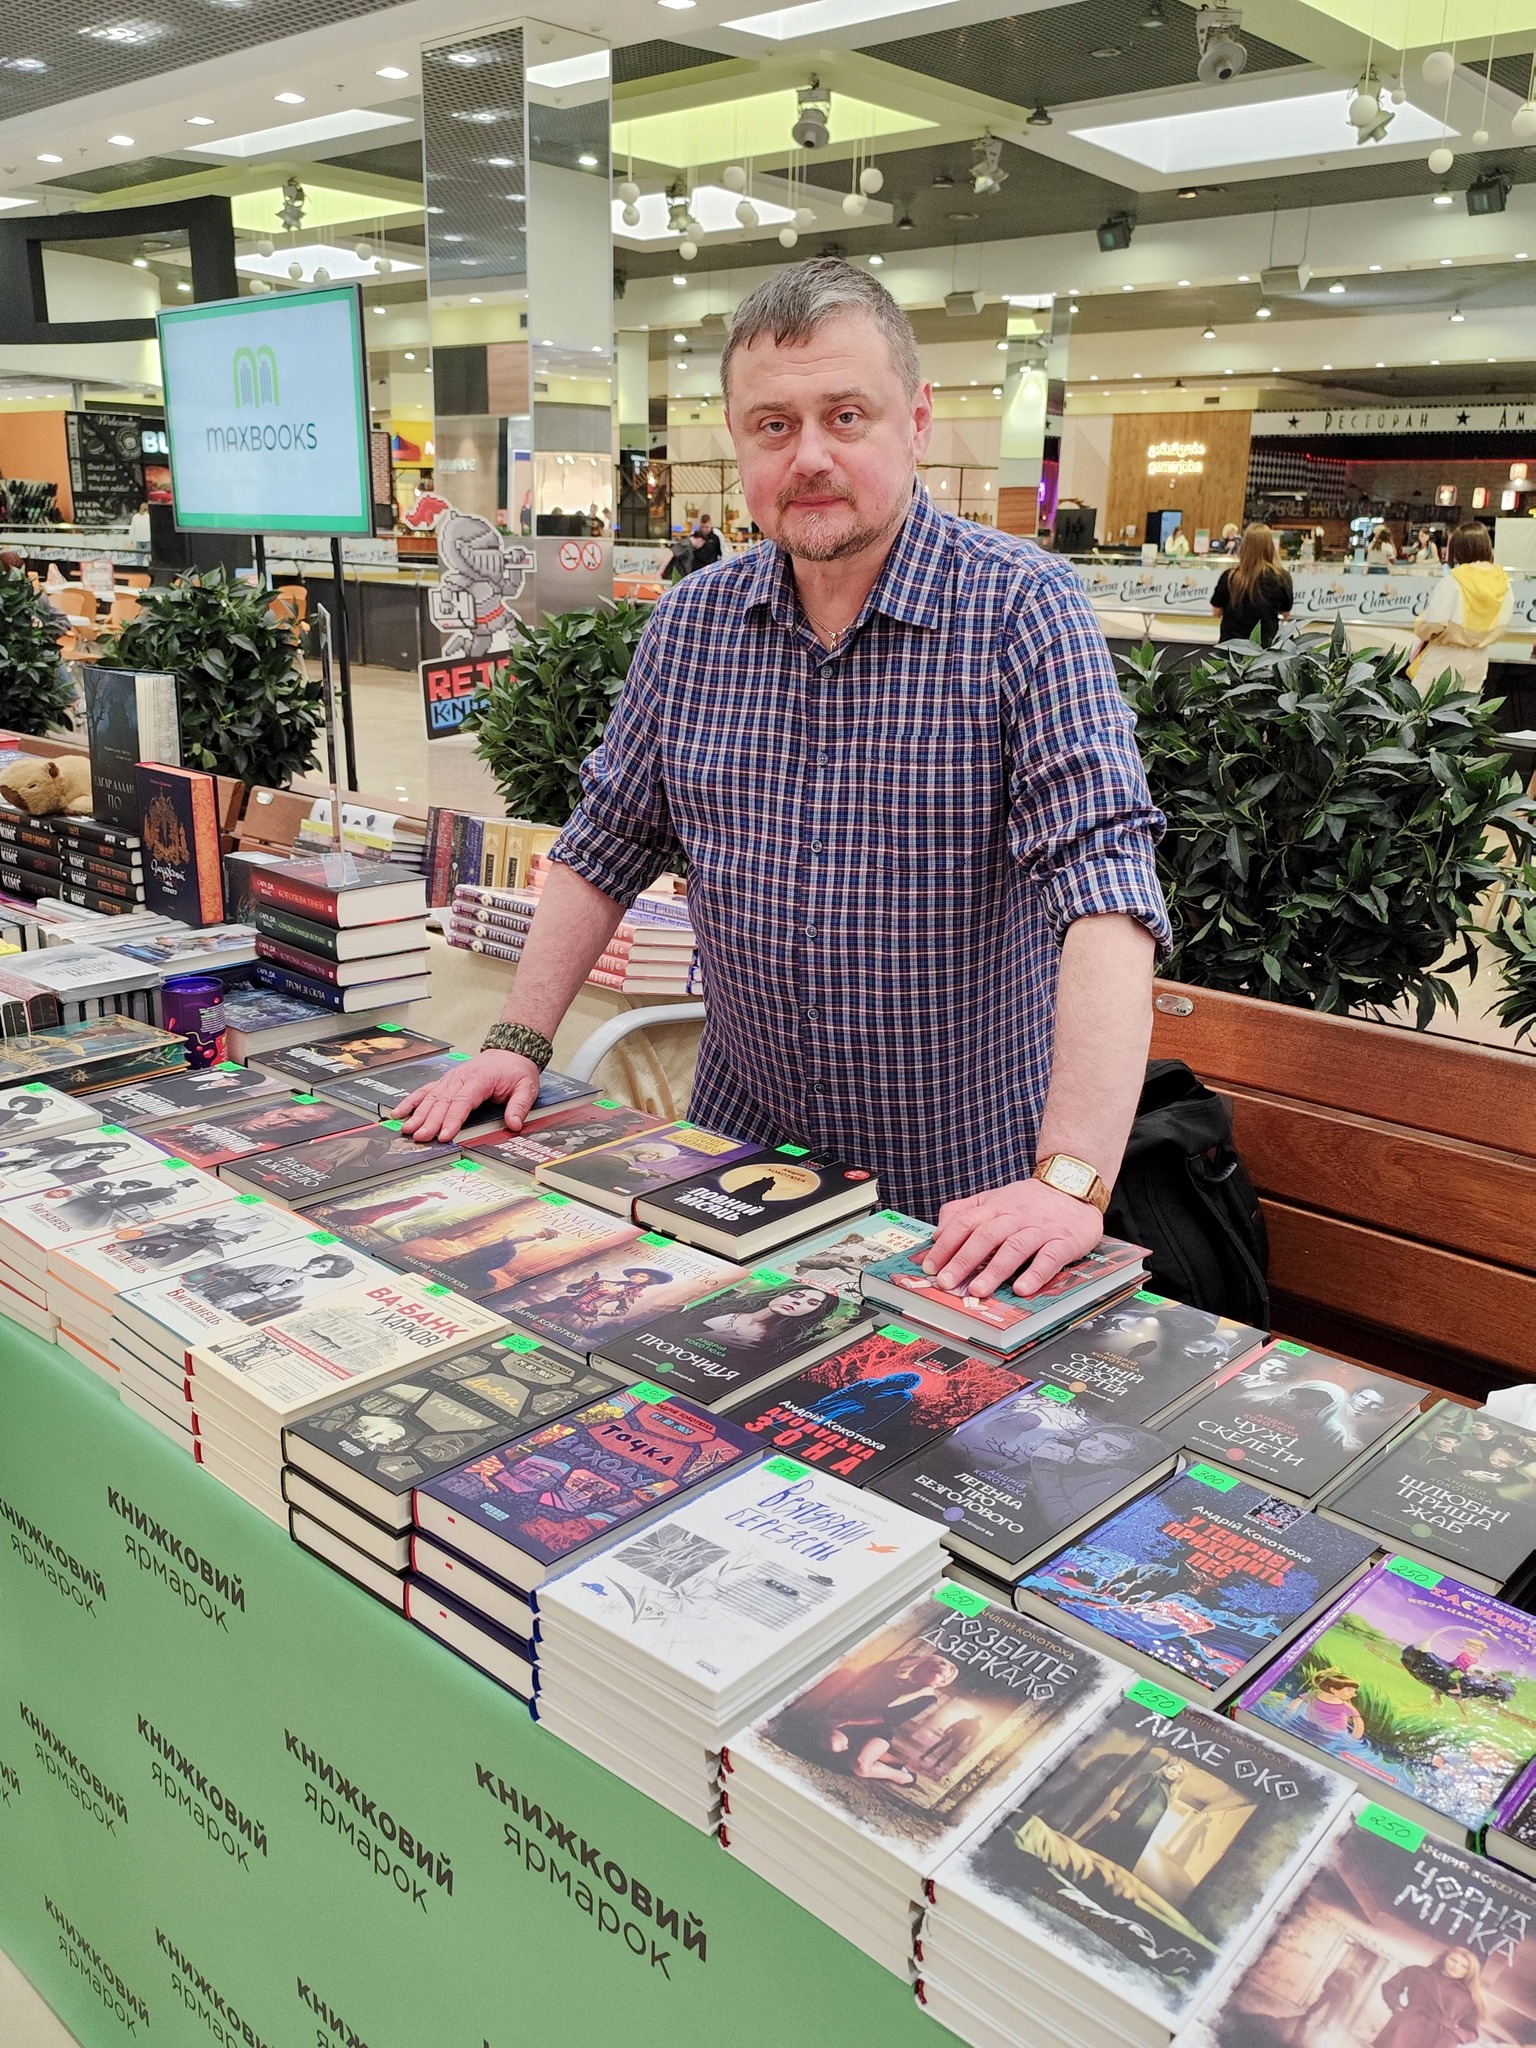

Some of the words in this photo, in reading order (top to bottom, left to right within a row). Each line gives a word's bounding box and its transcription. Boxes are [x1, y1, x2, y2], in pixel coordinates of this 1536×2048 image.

[1325, 411, 1428, 431] РЕСТОРАН
[1499, 409, 1536, 429] АМ
[206, 423, 317, 453] MAXBOOKS
[1164, 582, 1209, 604] Elovena
[1307, 588, 1357, 612] Elovena
[1359, 591, 1411, 615] Elovena
[107, 794, 122, 809] ПО
[285, 979, 302, 993] ТРОН
[308, 987, 326, 1000] СКЛА
[494, 1143, 551, 1163] ДЕРЖАВА
[254, 1158, 320, 1187] ДЖЕРЕЛО
[452, 1172, 514, 1201] ЖИТТЯ
[673, 1194, 741, 1222] МІСЯЦЬ
[688, 1187, 766, 1217] ПОВНИЙ
[166, 1288, 224, 1326] ВИГНАНЕЦЬ
[365, 1286, 469, 1340] ВА-БАНК
[375, 1313, 446, 1348] ХАРКОВІ
[683, 1337, 726, 1358] КОКОТЮХА
[635, 1333, 741, 1381] ПРОРОЧИЦЯ
[1069, 1361, 1128, 1386] СЕЗОН
[1071, 1353, 1145, 1384] ОСІННІЙ
[1051, 1363, 1129, 1396] СМЕРТЕЙ
[765, 1407, 876, 1461] АНОМАЛЬНА
[1234, 1417, 1299, 1448] ЧУЖІ
[1242, 1413, 1299, 1437] КОКОТЮХА
[1256, 1413, 1296, 1431] АНДРІЙ
[600, 1425, 675, 1466] ТОЧКА
[1198, 1420, 1306, 1467] СКЕЛЕТИ
[553, 1435, 656, 1489] ВИХОДУ
[769, 1463, 801, 1477] 270
[987, 1468, 1027, 1489] АНДРІЙ
[1194, 1470, 1225, 1485] 300
[953, 1472, 1024, 1511] ЛЕГЕНДА
[961, 1487, 996, 1508] ПРО
[973, 1468, 1028, 1498] КОКОТЮХА
[1397, 1474, 1511, 1524] ШЛЮБНІ
[1429, 1476, 1493, 1504] КОКОТЮХА
[1444, 1477, 1488, 1496] АНДРІЙ
[911, 1491, 946, 1511] ДЕТЕКТИВНА
[961, 1517, 988, 1533] АГЕНЦІЯ
[914, 1474, 1024, 1534] БЕЗГОЛОВОГО
[1396, 1485, 1492, 1532] ІГРИЩА
[1402, 1503, 1466, 1534] ЖАБ
[107, 1485, 246, 1614] КНИЖКОВИЙ
[1162, 1522, 1286, 1588] ПРИХОДИТЬ
[1183, 1515, 1207, 1528] У
[1201, 1523, 1295, 1572] ТЕМРЯВІ
[11, 1533, 98, 1619] ярмарок
[1186, 1552, 1233, 1579] ПЕС
[1392, 1565, 1430, 1583] 250
[124, 1534, 230, 1634] ярмарок
[941, 1591, 975, 1606] 250
[1458, 1587, 1491, 1605] Андрій
[1407, 1597, 1503, 1633] КОЗАЦЬКОГО
[941, 1610, 1078, 1686] РОЗБИТЕ
[1016, 1626, 1075, 1661] КОКОТЮХА
[920, 1627, 1055, 1701] ДЗЕРКАЛО
[1133, 1689, 1176, 1709] 250
[19, 1700, 129, 1825] КНИЖКОВИЙ
[1135, 1711, 1232, 1768] ЛИХЕ
[1235, 1759, 1300, 1801] ОКО
[34, 1742, 118, 1839] ярмарок
[137, 1712, 268, 1858] КНИЖКОВИЙ
[151, 1761, 251, 1873] ярмарок
[284, 1728, 455, 1897] КНИЖКОВИЙ
[1369, 1816, 1411, 1839] 250
[303, 1782, 428, 1914] ярмарок
[474, 1761, 709, 1963] КНИЖКОВИЙ
[502, 1822, 673, 1981] ярмарок
[1413, 1860, 1533, 1942] ЧОРНА
[1393, 1884, 1520, 1968] МІТКА
[44, 1894, 151, 2029] КНИЖКОВИЙ
[58, 1934, 138, 2039] ярмарок
